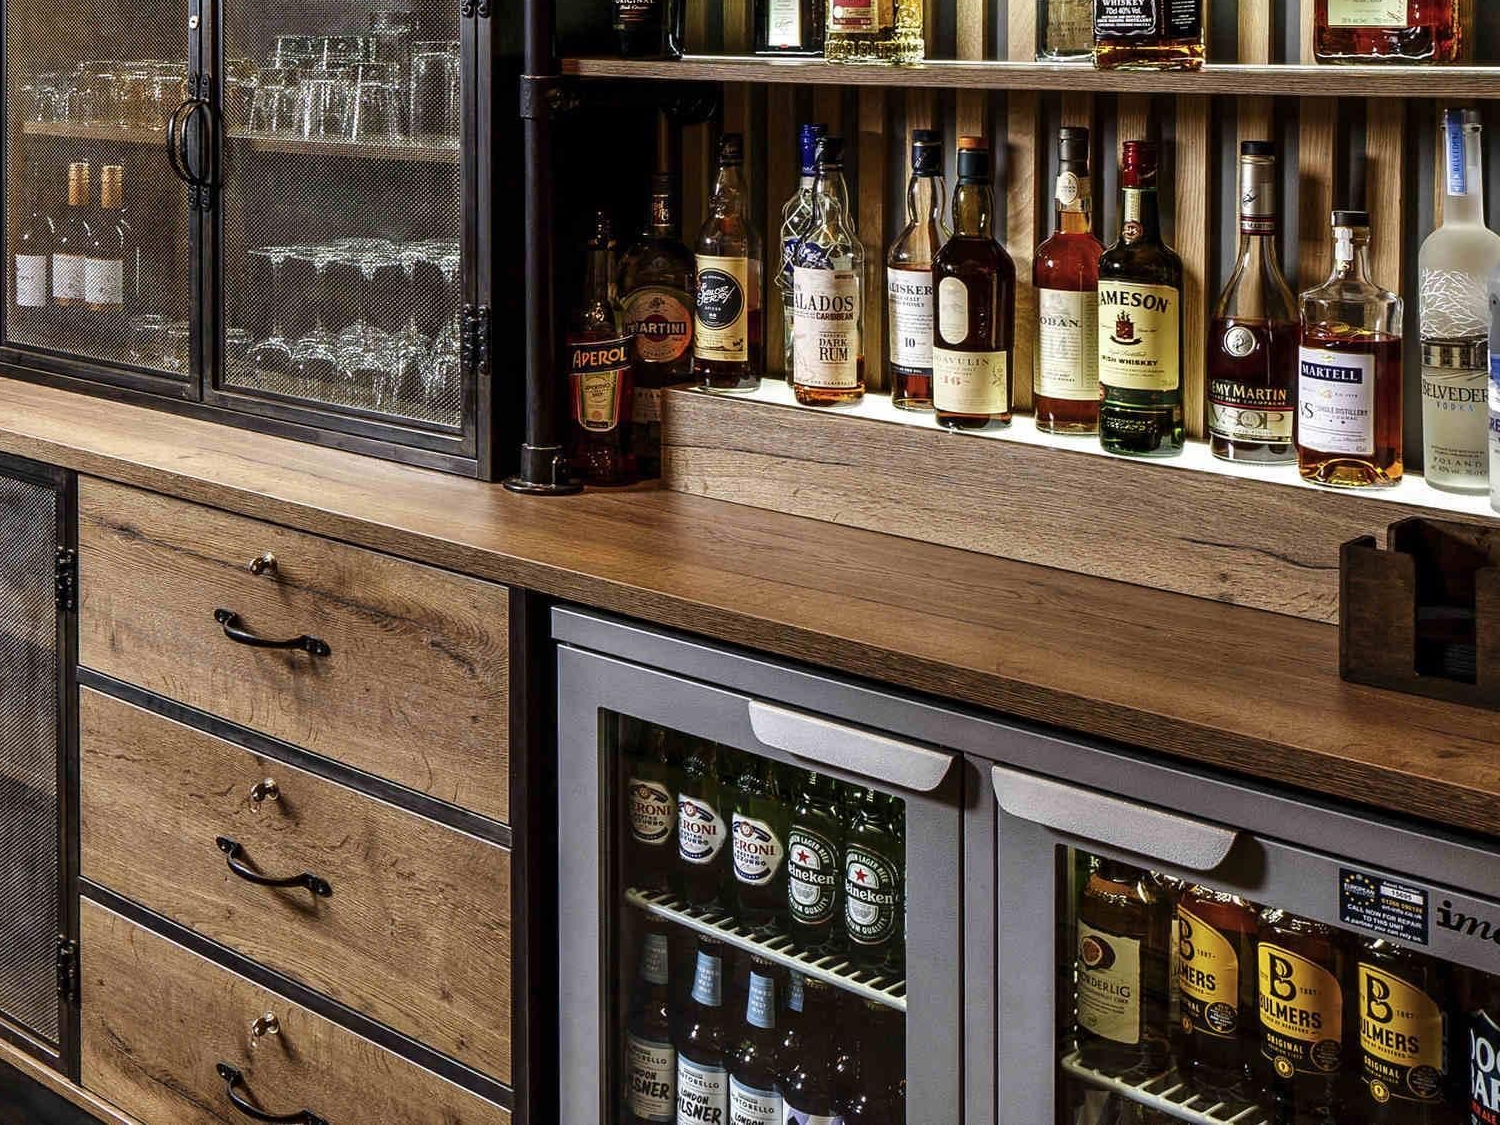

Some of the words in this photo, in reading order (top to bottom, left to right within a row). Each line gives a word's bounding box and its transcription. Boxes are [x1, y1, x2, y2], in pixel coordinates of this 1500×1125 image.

[628, 322, 686, 335] MARTINI
[1040, 316, 1079, 328] OBAN
[819, 338, 848, 347] DARK
[904, 337, 916, 349] 10
[572, 346, 628, 369] APEROL
[819, 347, 848, 362] RUM
[1119, 357, 1158, 366] WHISKEY
[1302, 363, 1359, 380] MARTELL
[1233, 383, 1287, 401] MARTIN
[1436, 401, 1475, 411] VODKA
[1433, 456, 1483, 468] POLAND
[801, 837, 819, 851] LAGER
[818, 848, 830, 865] BEER
[858, 854, 878, 870] LAGER
[803, 895, 830, 915] QUALITY
[861, 915, 888, 935] QUALITY
[1347, 903, 1365, 914] CALL
[1365, 908, 1382, 918] NOW
[1382, 913, 1397, 922] FOR
[1397, 917, 1422, 930] REPAIR
[1363, 914, 1372, 922] TO
[1373, 917, 1388, 927] THIS
[1389, 922, 1404, 931] UNIT
[1351, 918, 1373, 928] partner
[1374, 925, 1386, 933] you
[1268, 951, 1297, 1002] B
[1366, 973, 1394, 1024] B
[1267, 1033, 1304, 1054] ORIGINAL
[1364, 1054, 1400, 1079] ORIGINAL
[680, 1087, 709, 1106] LONDON
